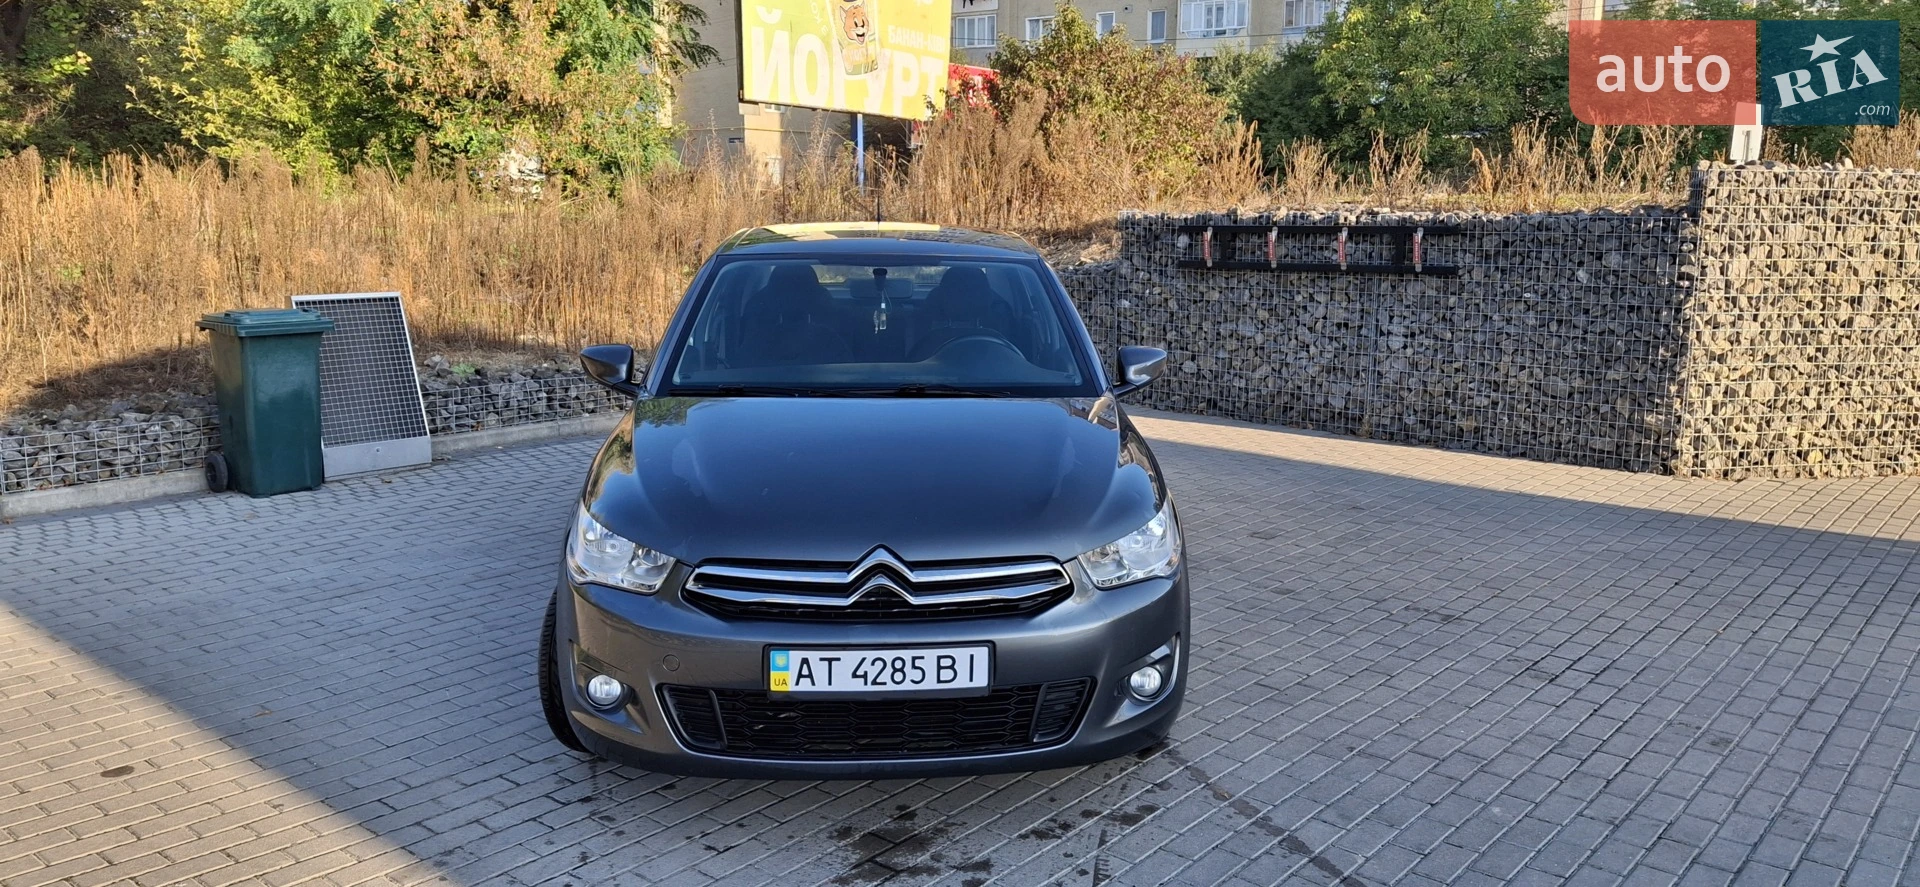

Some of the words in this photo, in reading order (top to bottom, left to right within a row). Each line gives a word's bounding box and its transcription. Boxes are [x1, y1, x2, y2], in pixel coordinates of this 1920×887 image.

[794, 657, 841, 686] AT
[851, 655, 926, 686] 4285
[773, 677, 788, 687] UA
